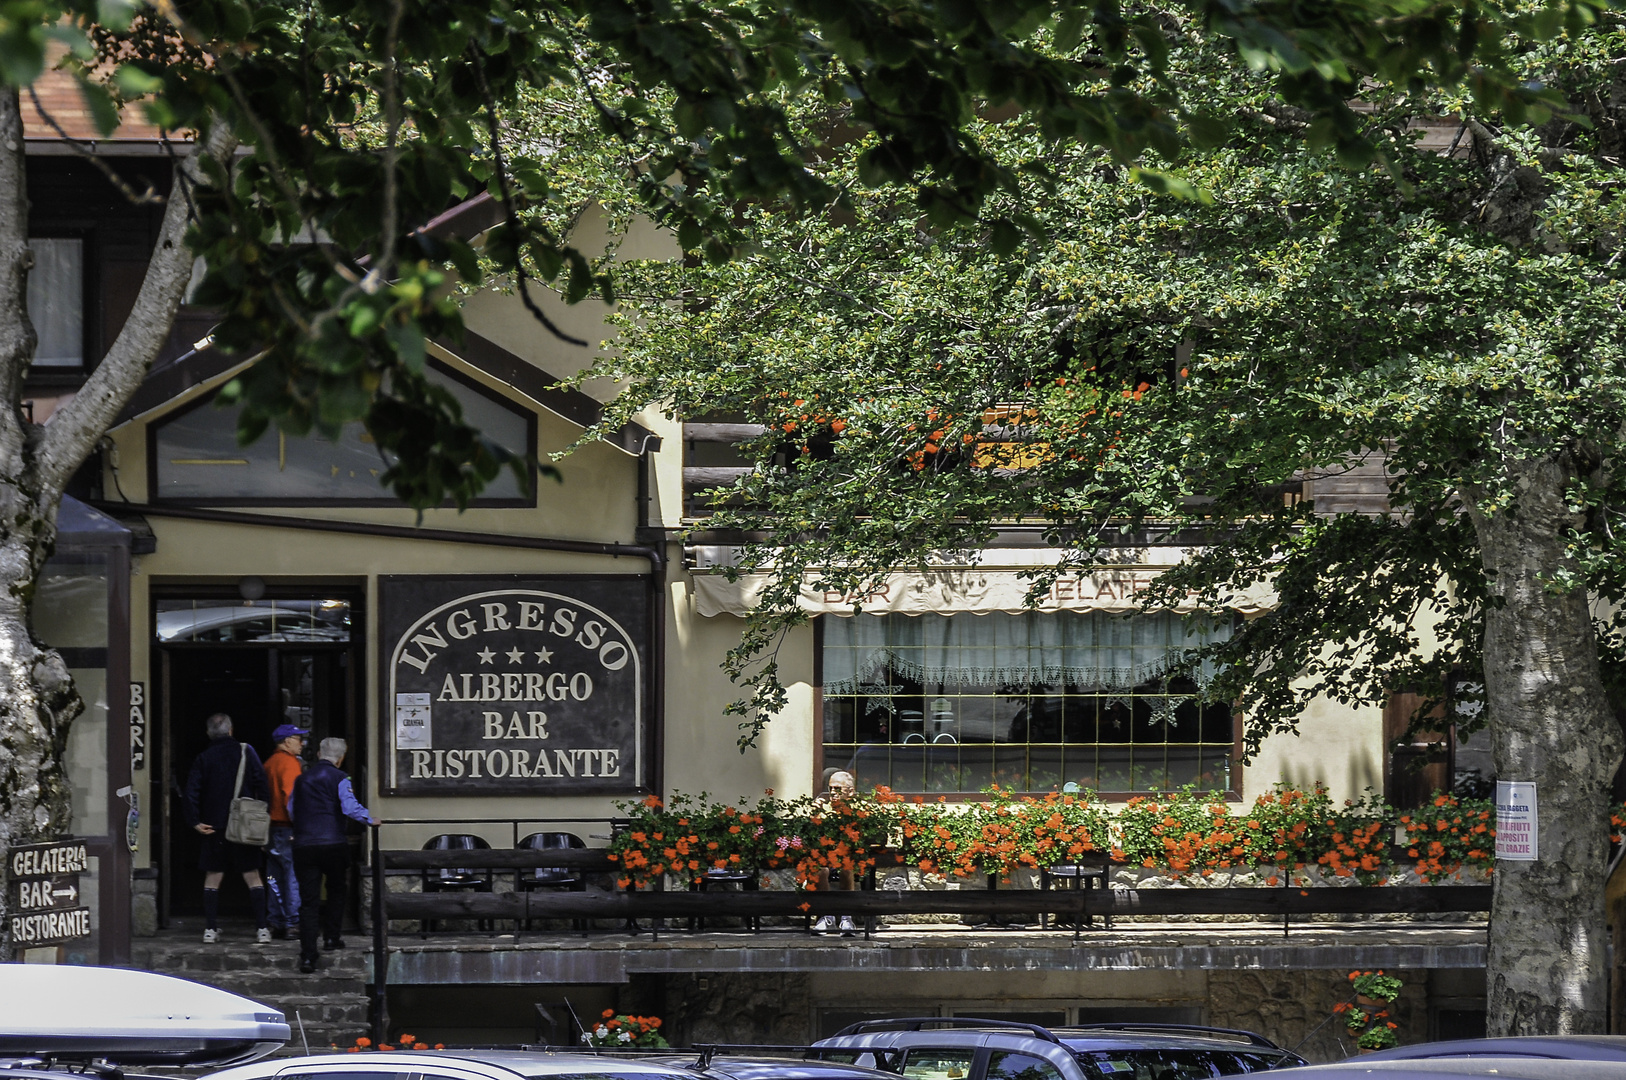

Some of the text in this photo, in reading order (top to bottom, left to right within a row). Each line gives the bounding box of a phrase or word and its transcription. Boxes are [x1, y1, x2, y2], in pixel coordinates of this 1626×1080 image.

[823, 579, 1205, 604] BAR ELATE
[398, 601, 629, 675] INGRESSO
[436, 672, 594, 702] ALBERGO
[129, 683, 144, 748] BAR
[482, 711, 549, 740] BAR
[410, 749, 620, 779] RISTORANTE
[1505, 822, 1531, 832] RIFIUTI
[13, 845, 88, 876] GELATERIA
[1506, 844, 1530, 853] GRAZIE
[20, 881, 54, 909] BAR
[12, 910, 90, 942] RISTORANTE
